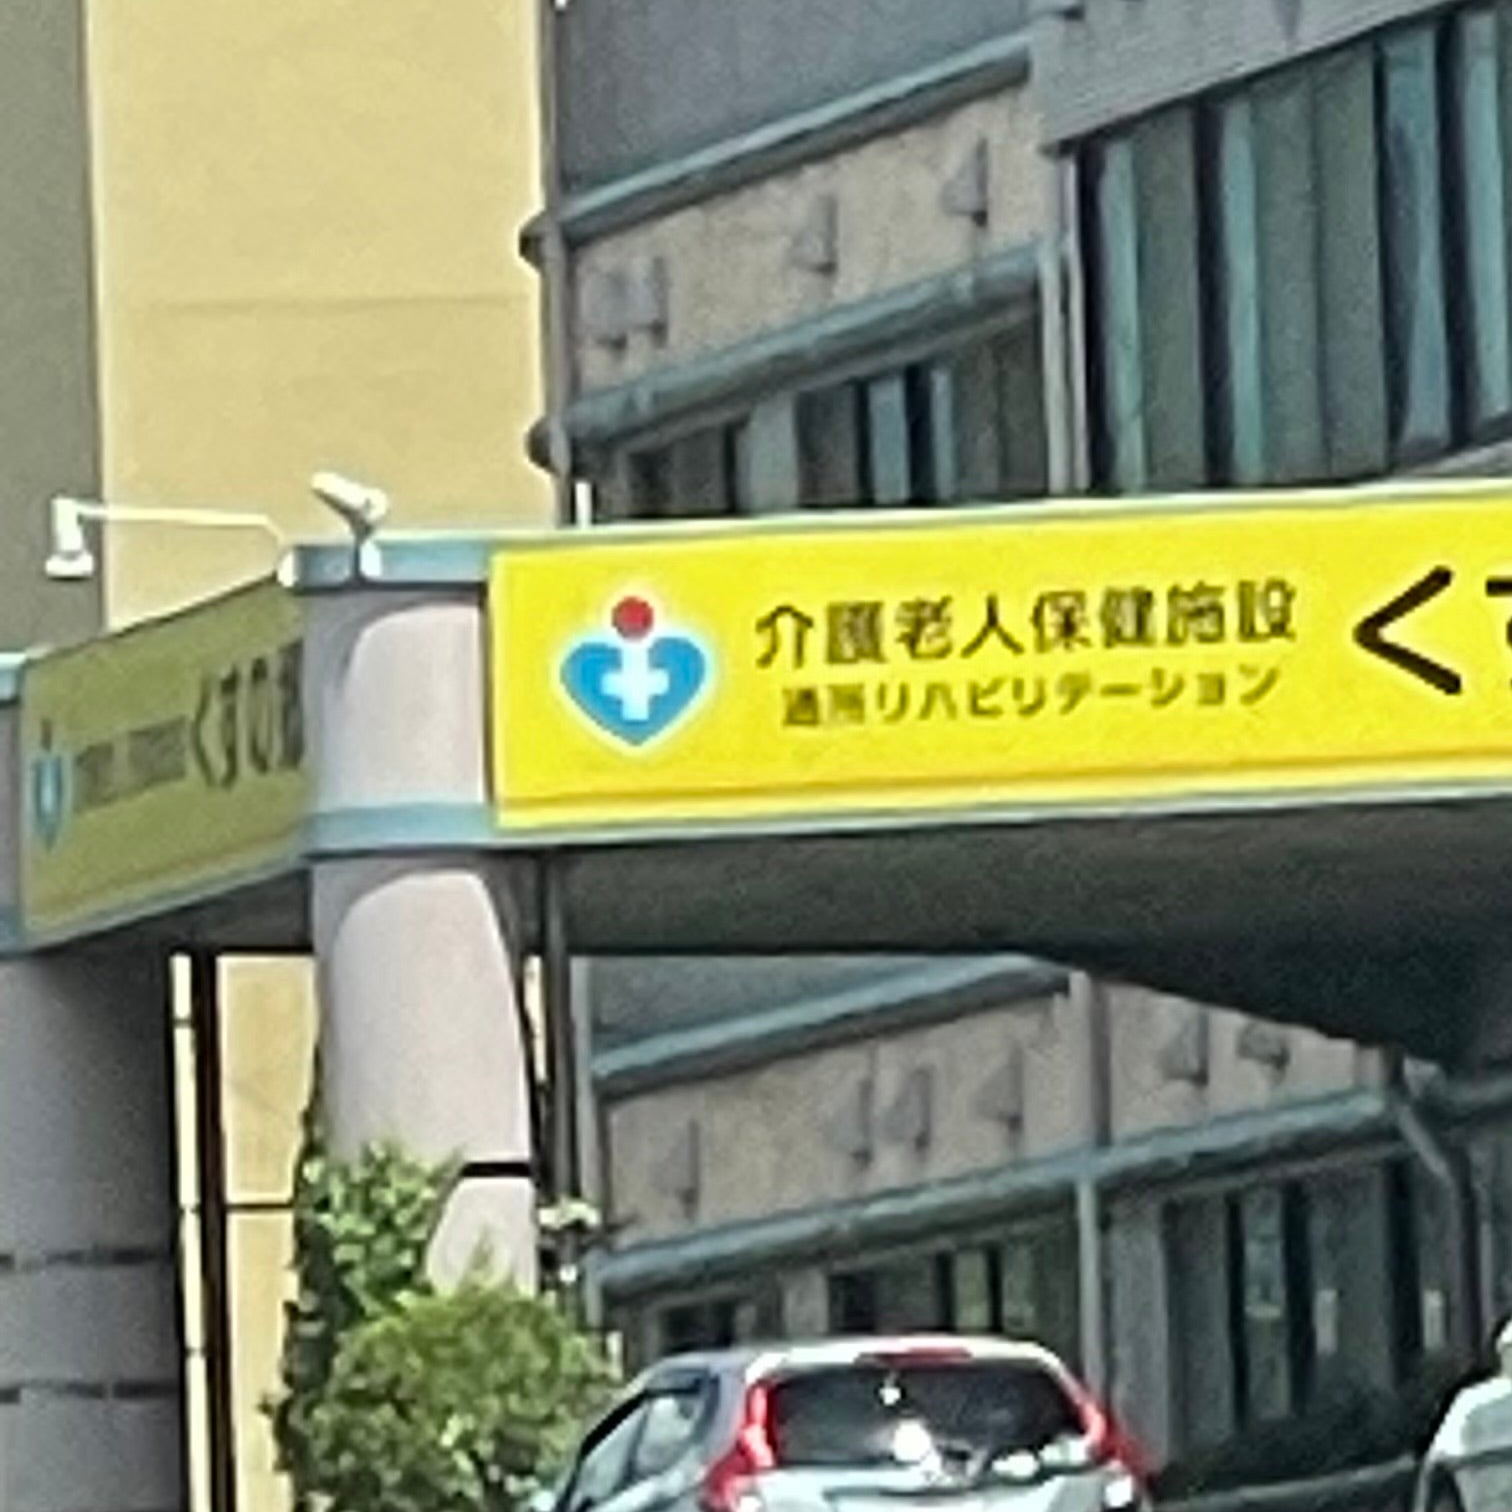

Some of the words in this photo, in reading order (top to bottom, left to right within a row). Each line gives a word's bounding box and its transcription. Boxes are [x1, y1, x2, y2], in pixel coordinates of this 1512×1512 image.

[755, 578, 1296, 669] 介護老人保健施設
